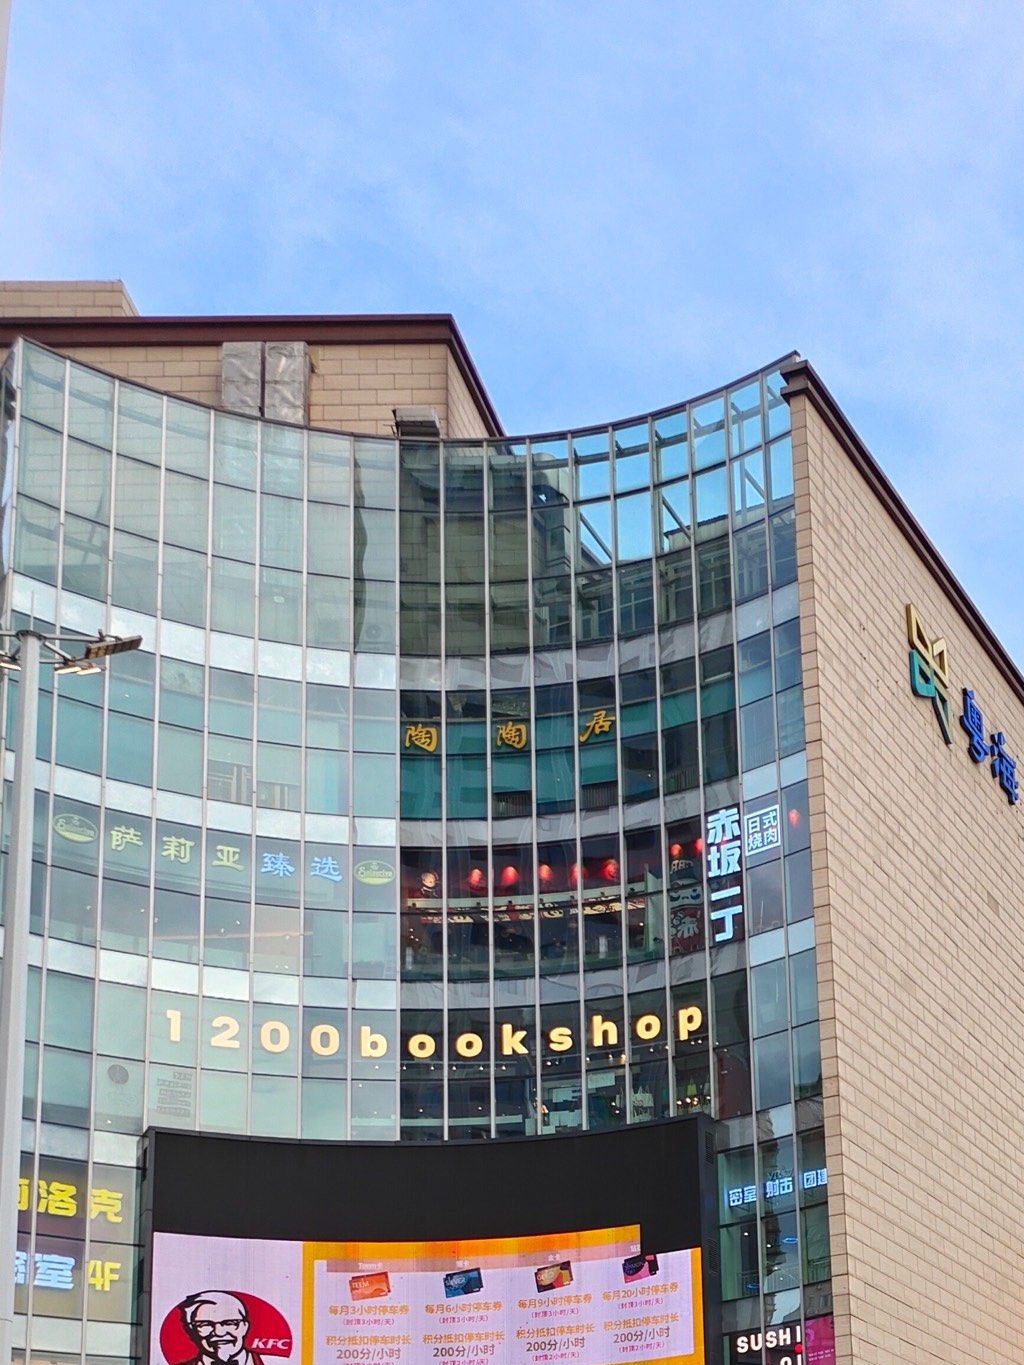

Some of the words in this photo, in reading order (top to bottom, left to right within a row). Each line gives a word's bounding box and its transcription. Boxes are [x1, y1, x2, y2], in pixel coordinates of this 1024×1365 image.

[404, 711, 616, 752] 陶陶居
[959, 687, 1019, 806] 粤海
[748, 811, 777, 833] 日式
[748, 829, 777, 849] 烧肉
[707, 808, 743, 943] 赤坂一丁
[165, 1004, 703, 1058] 1200bookshop
[728, 1185, 757, 1207] 密室
[765, 1176, 794, 1198] 射击
[18, 1176, 124, 1224] 洛克
[87, 1260, 121, 1292] 4F
[251, 1337, 291, 1350] KFC
[526, 1336, 586, 1352] 200分/小时
[613, 1326, 671, 1344] 200分/小时
[736, 1326, 801, 1354] SUSHI
[336, 1348, 401, 1360] 200分/小时
[432, 1344, 496, 1358] 200分/小时
